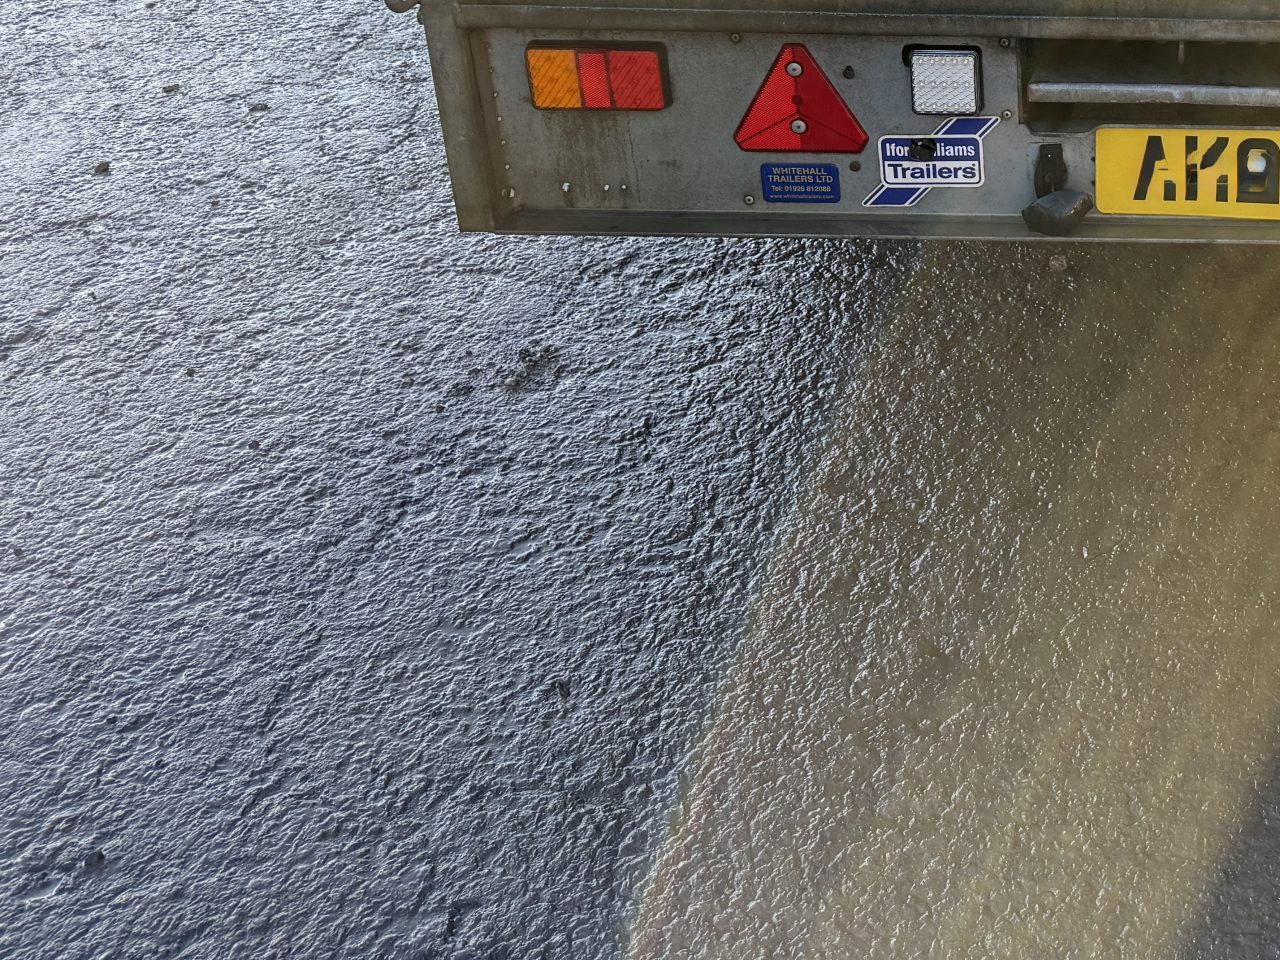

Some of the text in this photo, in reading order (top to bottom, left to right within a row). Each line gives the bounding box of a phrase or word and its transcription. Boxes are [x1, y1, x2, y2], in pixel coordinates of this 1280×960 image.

[885, 143, 910, 157] Ifor
[772, 167, 828, 175] WHITEHALL
[887, 163, 977, 179] Trailers
[768, 175, 834, 183] TRAILERS LTD
